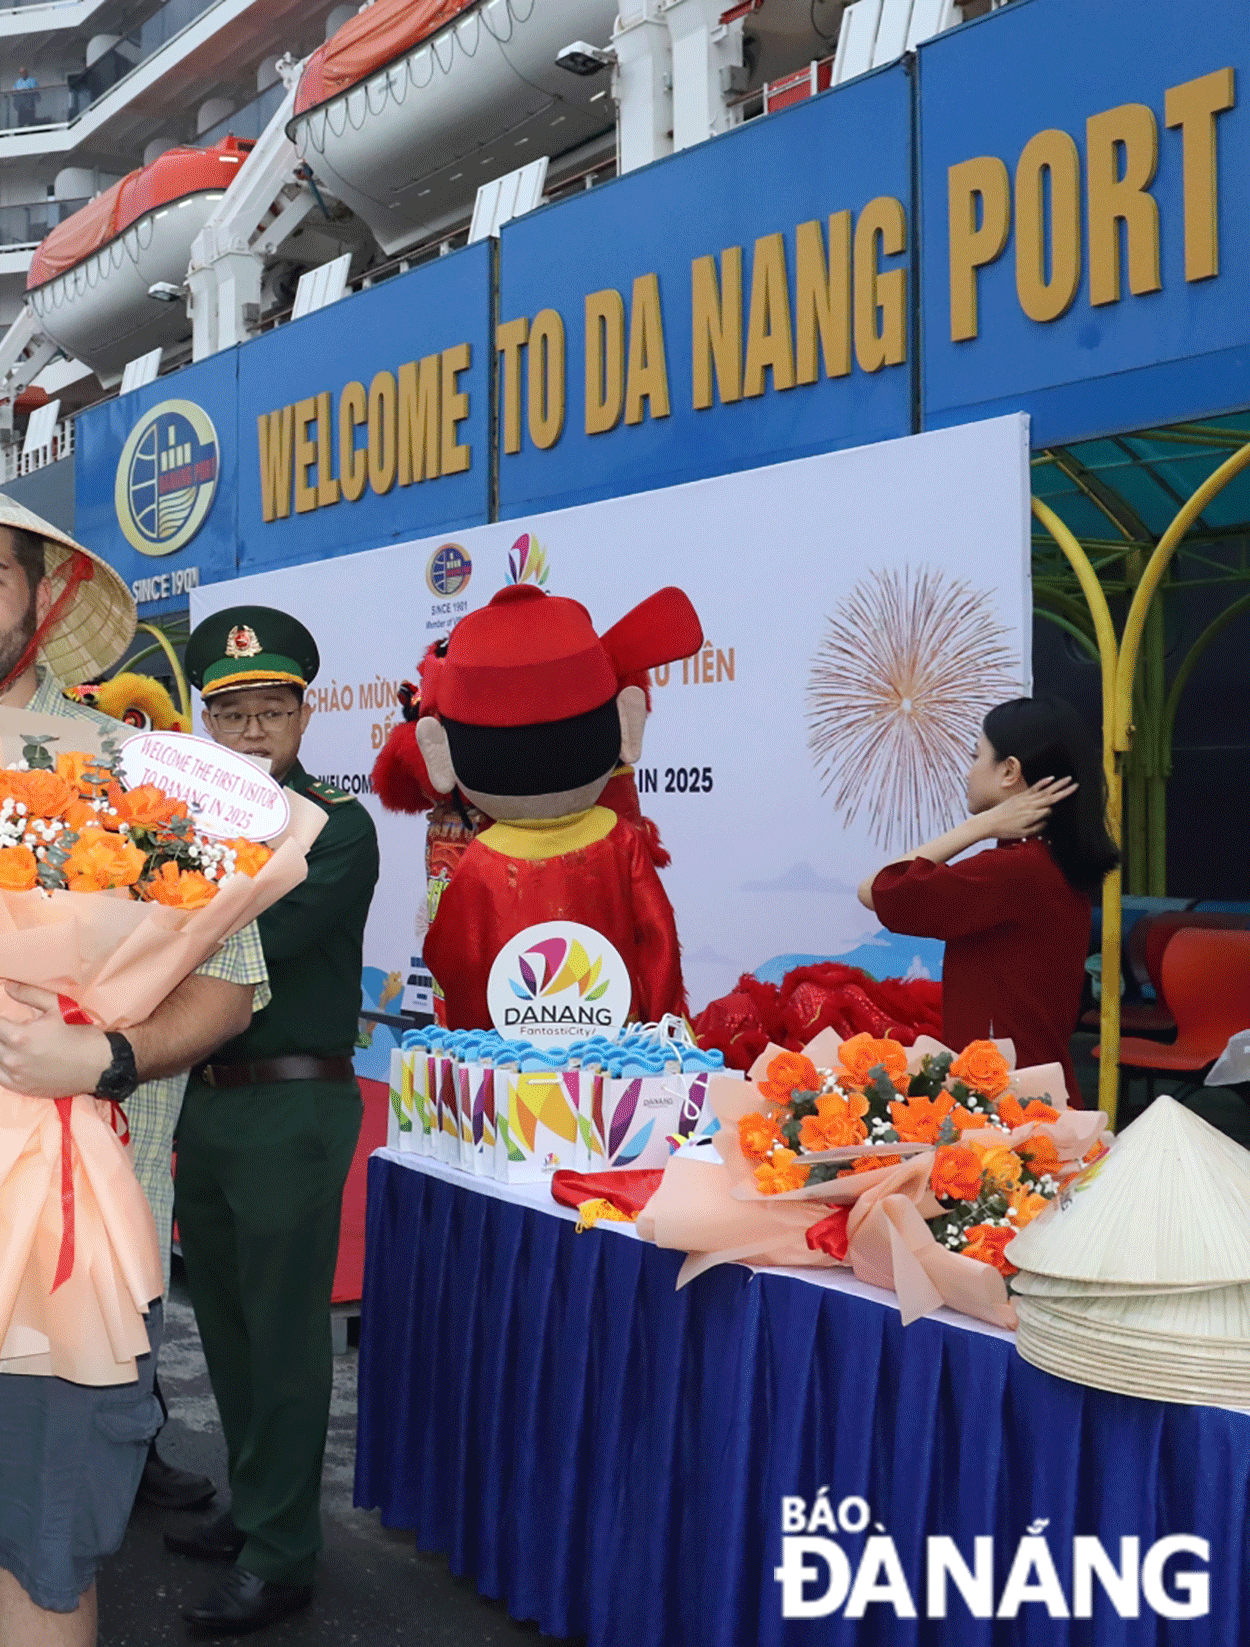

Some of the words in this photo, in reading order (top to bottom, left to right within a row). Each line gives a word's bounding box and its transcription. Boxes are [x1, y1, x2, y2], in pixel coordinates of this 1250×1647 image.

[258, 343, 471, 522] WELCOME
[496, 308, 565, 455] TO
[584, 272, 670, 435] DA
[691, 196, 907, 411] NANG
[948, 66, 1235, 342] PORT
[132, 573, 171, 603] SINCE
[431, 602, 451, 615] SINCE
[305, 679, 354, 712] CHÀO
[359, 674, 408, 710] MỪN
[370, 711, 398, 750] ĐẾ
[140, 737, 193, 774] WELCOME
[190, 757, 215, 783] THE
[211, 768, 242, 797] FIRST
[238, 778, 279, 811] VISITOR
[318, 773, 375, 795] ELCOM
[639, 768, 657, 793] IN
[664, 767, 714, 793] 2025
[208, 798, 226, 818] IN
[223, 805, 254, 830] 2025
[504, 1005, 612, 1026] DANANG
